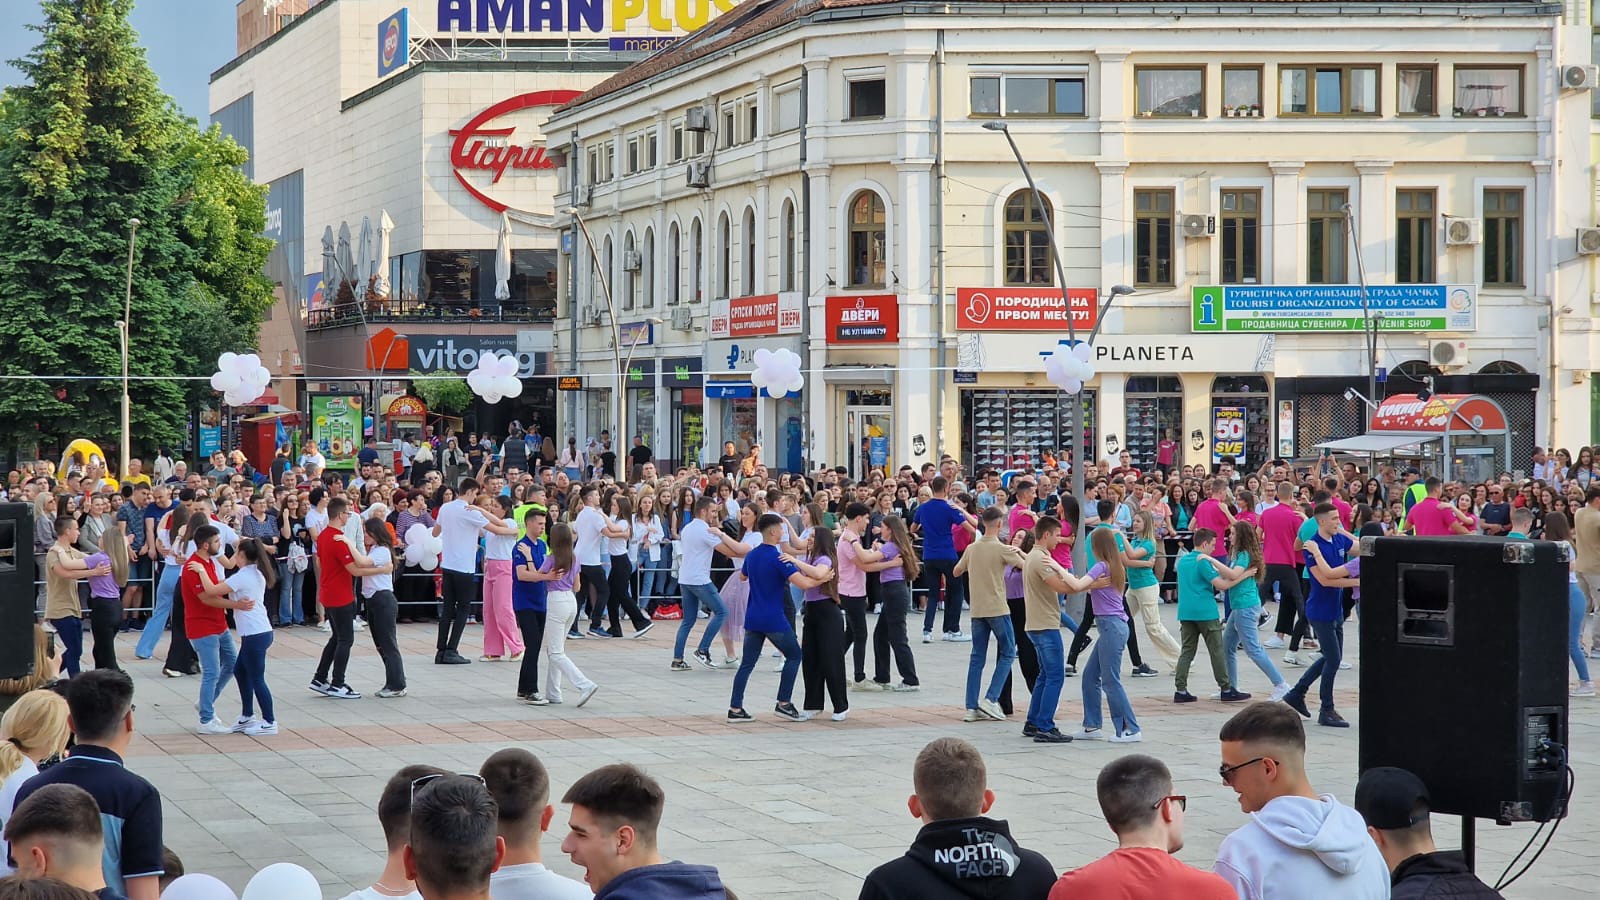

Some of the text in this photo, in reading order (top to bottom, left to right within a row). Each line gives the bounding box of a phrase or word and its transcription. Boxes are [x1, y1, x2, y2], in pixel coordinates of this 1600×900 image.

[437, 0, 738, 33] AMAN PLU
[624, 37, 677, 50] marke
[449, 126, 556, 184] Пари
[1230, 289, 1294, 298] ТУРИСТИЧКА
[1372, 288, 1403, 297] ГРАДА
[1405, 288, 1439, 297] ЧАЧКА
[995, 297, 1089, 308] ПОРОДИЦА НА
[1231, 299, 1275, 308] TOURIST
[1277, 299, 1356, 308] ORGANIZATION
[1386, 299, 1400, 307] OF
[731, 302, 777, 319] СРПСКИ ПОКРЕТ
[841, 309, 880, 322] ДВЕРИ
[995, 310, 1041, 320] ПРВОМ
[711, 318, 728, 332] ДВЕРИ
[781, 311, 801, 327] ДВЕРИ
[1241, 320, 1300, 330] ПРОДАВНИЦА
[1302, 319, 1348, 330] СУВЕНИРА
[1407, 319, 1432, 328] SHOP
[416, 339, 536, 379] vitog
[1096, 346, 1195, 361] PLANETA
[1215, 418, 1244, 441] 50
[1214, 442, 1244, 454] SVE
[961, 828, 995, 845] THE
[934, 842, 1001, 864] NORTH
[956, 860, 1003, 880] FACE
